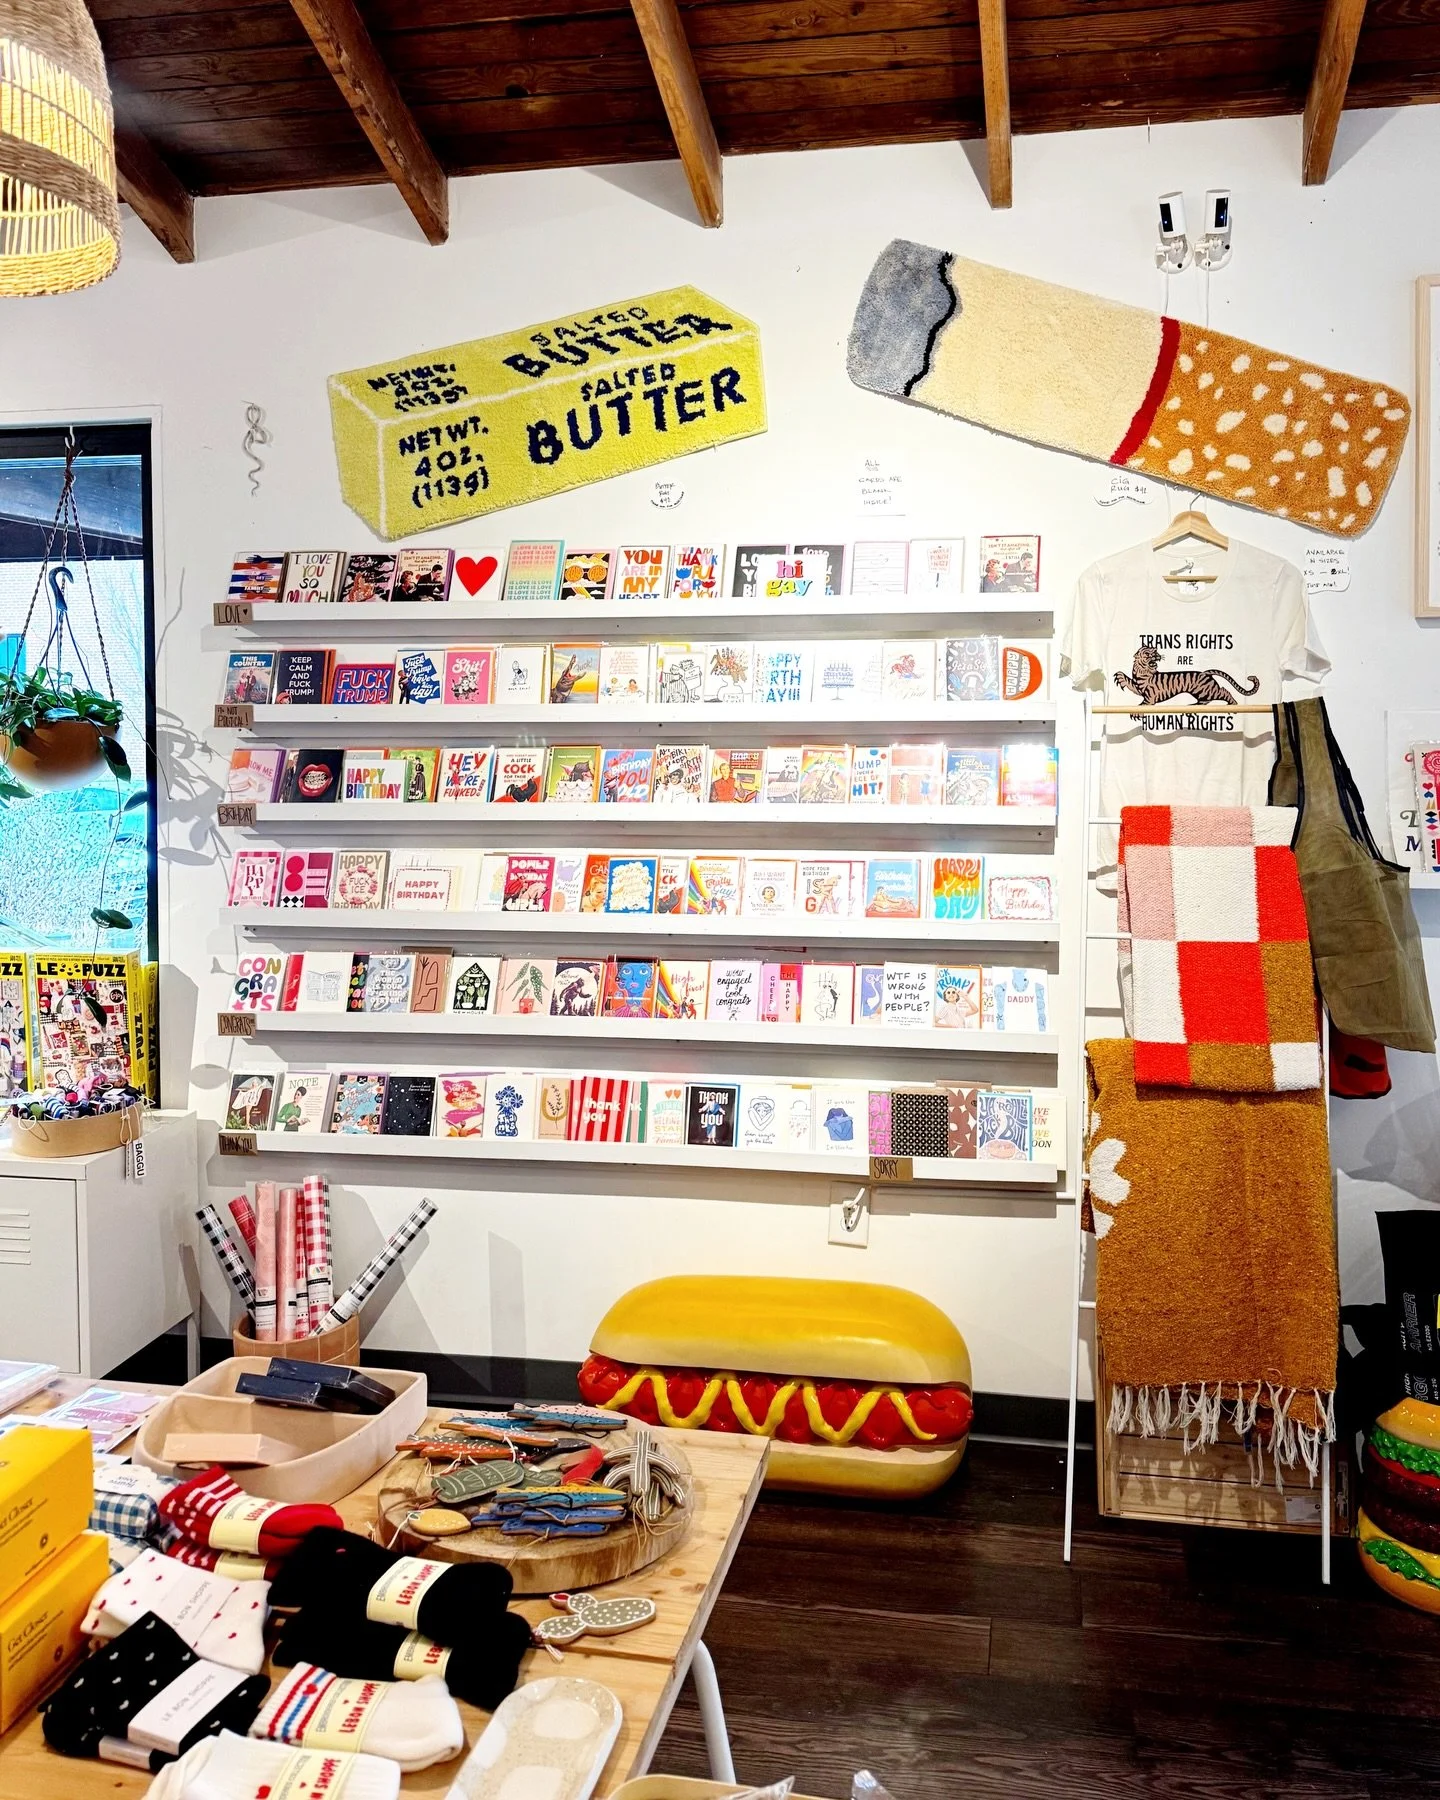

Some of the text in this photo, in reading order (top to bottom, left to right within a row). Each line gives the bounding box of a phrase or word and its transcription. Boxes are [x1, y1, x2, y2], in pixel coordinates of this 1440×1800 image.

[529, 307, 649, 347] SALTED
[502, 314, 732, 378] BUTTER
[581, 363, 676, 401] SALTED
[526, 367, 747, 465] BUTTER
[306, 553, 334, 565] LOVE
[623, 549, 663, 565] YOU
[302, 565, 325, 578] YOU
[621, 565, 646, 576] ARE
[776, 560, 804, 579] hi
[299, 578, 319, 589] SO
[766, 579, 813, 597] gay
[217, 604, 242, 624] LOVE
[1139, 634, 1233, 650] TRANS RIGHTS
[290, 656, 311, 664] KEEP
[452, 657, 487, 674] Shit!
[1177, 655, 1194, 666] ARE
[289, 680, 311, 688] FUCK
[337, 669, 390, 689] FUCK
[284, 688, 315, 696] TRUMP!
[336, 689, 388, 704] TRUMP
[226, 706, 238, 716] NOT
[1142, 715, 1234, 731] HUMAN RIGHTS
[249, 761, 274, 777] LOW ME
[449, 753, 487, 771] HEY
[503, 764, 536, 774] COCK
[347, 768, 386, 784] HAPPY
[617, 768, 649, 787] YOU
[345, 784, 401, 800] BIRTHDAY
[852, 782, 884, 796] HIT!
[218, 805, 253, 825] BIRTHDAY
[339, 854, 383, 870] HAPPY
[348, 877, 370, 886] FUCK
[352, 885, 366, 894] ICE
[405, 880, 439, 888] HAPPY
[397, 890, 446, 900] BIRTHDAY
[805, 896, 841, 915] GAY
[36, 962, 127, 978] LE PUZZ
[238, 957, 282, 977] CON
[716, 975, 752, 990] engaged
[886, 971, 927, 981] WTF IS
[235, 973, 277, 1001] GRA
[725, 989, 746, 999] cool
[887, 982, 926, 991] WRONG
[249, 992, 272, 1011] TS
[715, 997, 752, 1008] congrats
[893, 992, 920, 1000] WITH
[1007, 995, 1035, 1003] DADDY
[885, 1001, 930, 1012] PEOPLE?
[220, 1015, 251, 1035] CONGRATS
[134, 1013, 145, 1060] PUZZ
[288, 1077, 320, 1089] NOTE
[585, 1097, 621, 1112] thank
[1034, 1107, 1050, 1116] IVE
[583, 1112, 607, 1124] you
[1033, 1130, 1050, 1138] OVE
[219, 1135, 253, 1153] THANK YOU
[1032, 1140, 1052, 1148] OON
[135, 1143, 145, 1177] BAGGU
[873, 1158, 899, 1179] SORRY
[396, 1581, 422, 1606] LEBON
[338, 1682, 381, 1733] LEBON SHOPPE
[314, 1758, 342, 1789] SHOPPE
